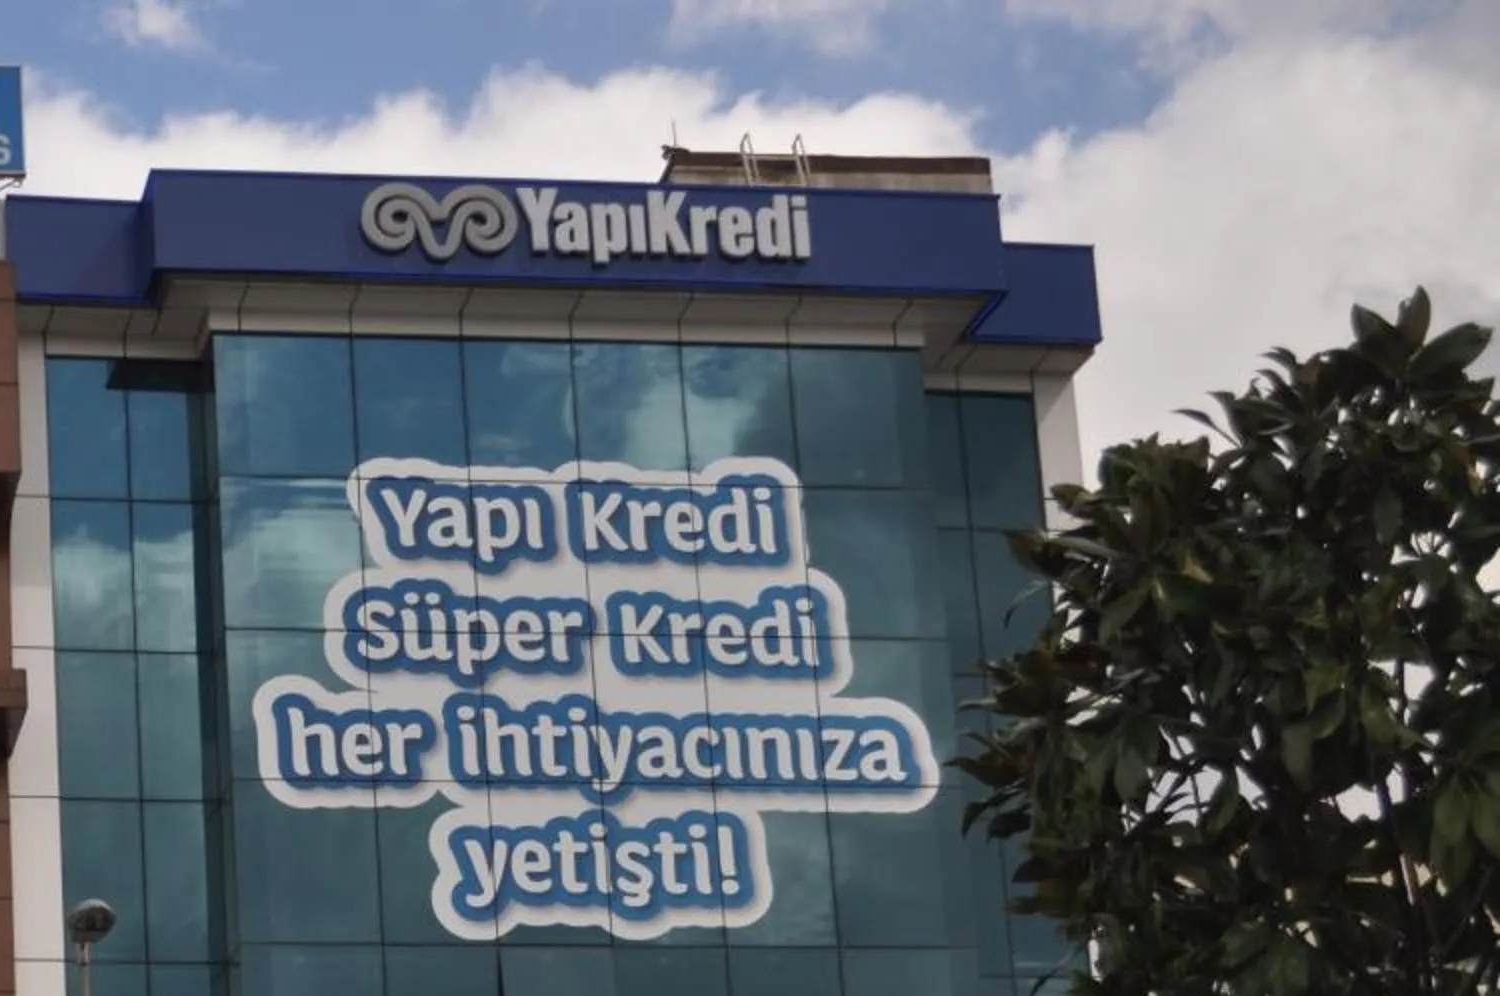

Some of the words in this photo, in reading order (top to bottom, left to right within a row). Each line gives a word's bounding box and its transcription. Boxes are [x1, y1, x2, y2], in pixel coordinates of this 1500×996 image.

[377, 486, 544, 561] Yapı
[579, 486, 780, 556] Kredi
[355, 591, 583, 675] Süper
[619, 598, 820, 667] Kredi
[286, 705, 426, 776] her
[455, 705, 908, 792] ihtiyacınıza
[462, 822, 742, 907] yetişti!
